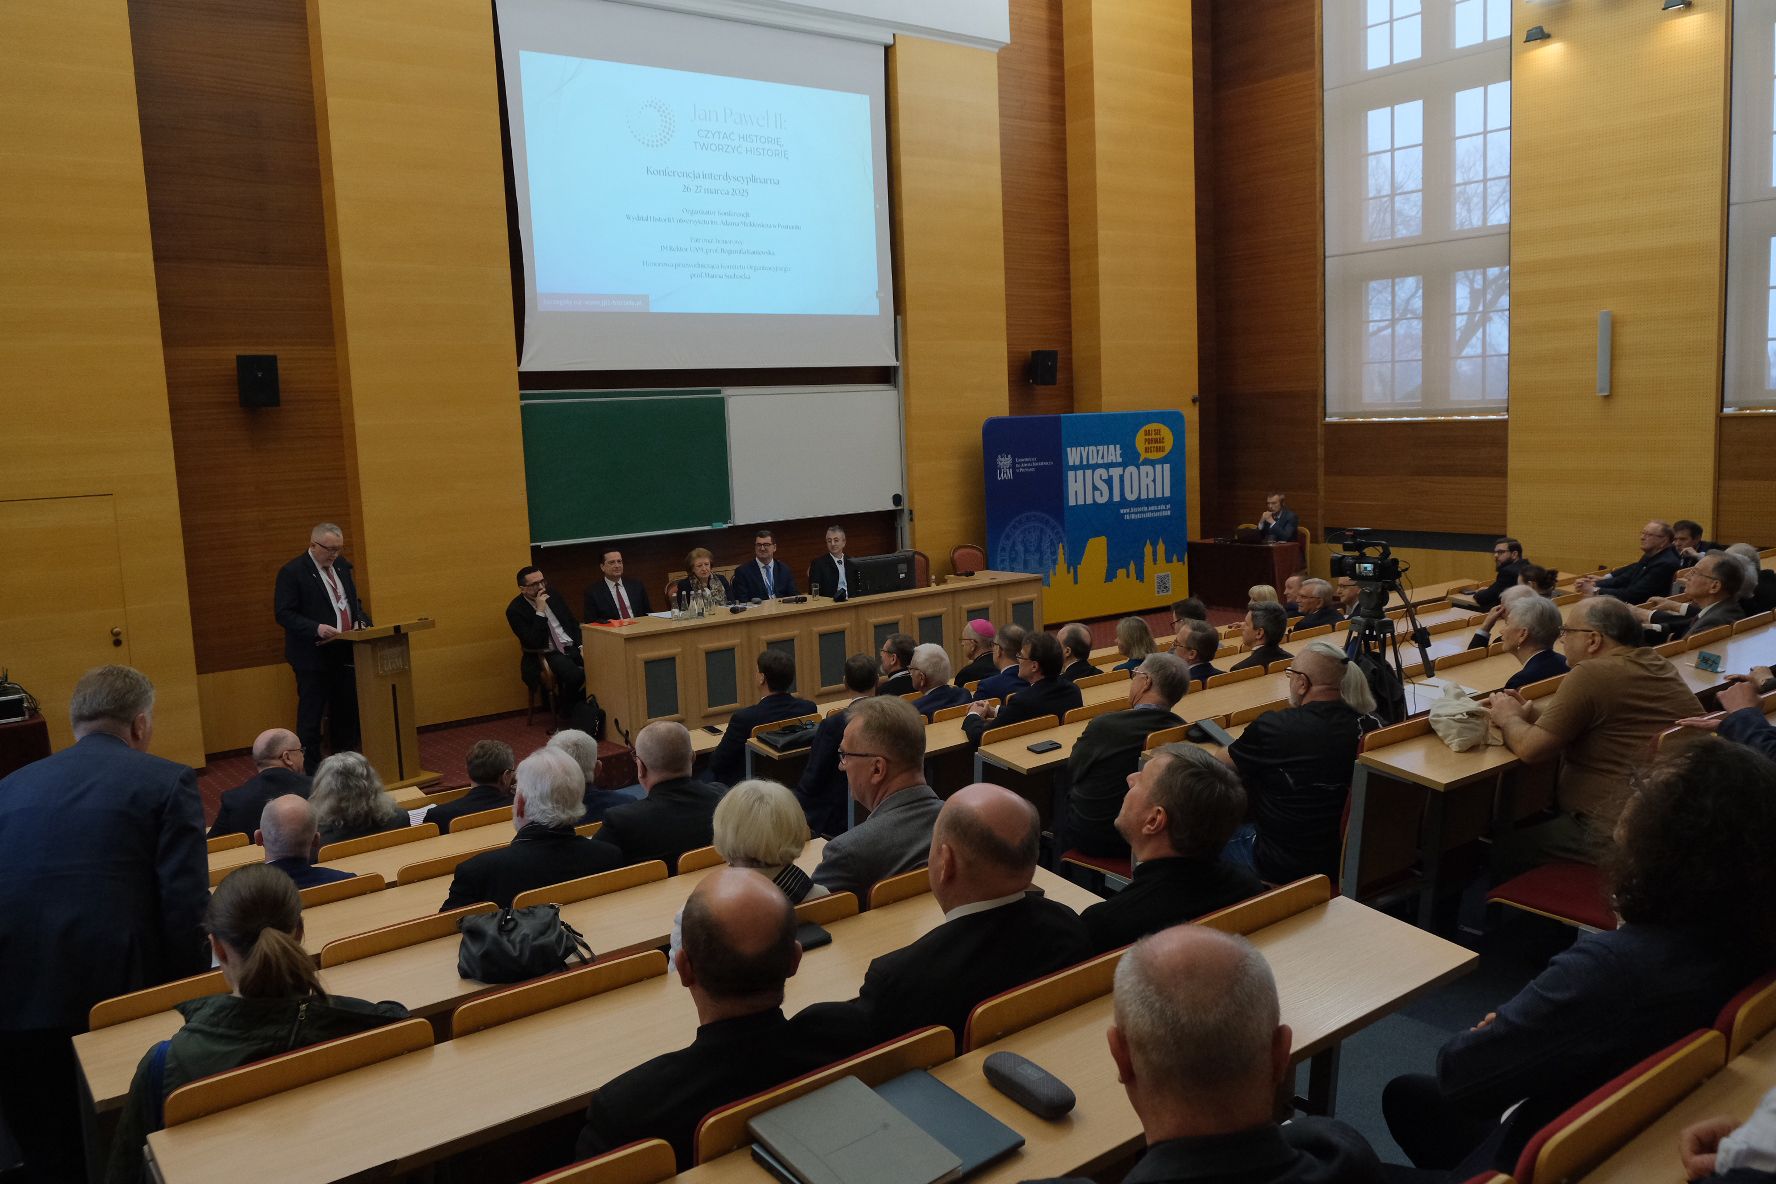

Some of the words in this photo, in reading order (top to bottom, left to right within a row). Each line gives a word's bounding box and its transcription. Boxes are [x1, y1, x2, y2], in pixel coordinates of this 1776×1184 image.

[690, 103, 720, 123] Jan
[697, 128, 735, 143] CZYTAĆ
[693, 141, 743, 155] TWORZYĆ
[745, 146, 789, 160] HISTORIĘ
[645, 166, 701, 181] Konferencja
[702, 170, 780, 186] interdyscyplinarna
[704, 186, 730, 197] marca
[731, 186, 750, 199] 2025
[1067, 445, 1123, 466] WYDZIAŁ
[1068, 464, 1171, 506] HISTORII
